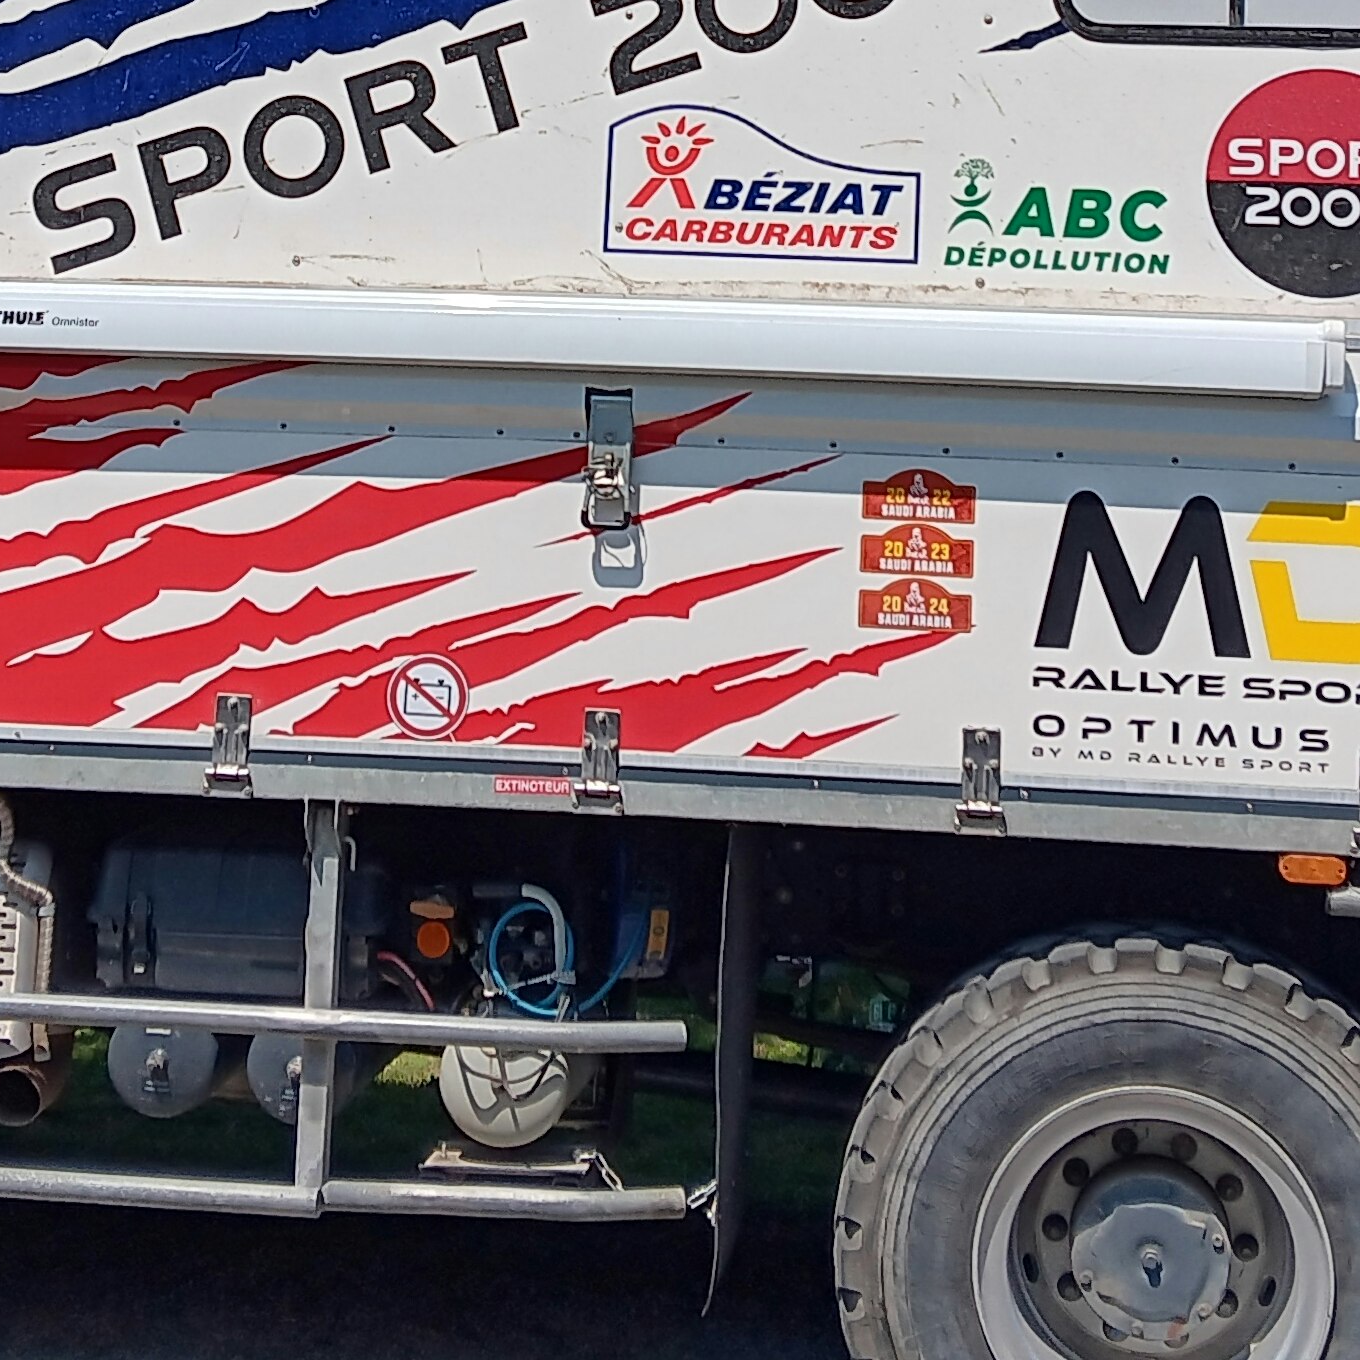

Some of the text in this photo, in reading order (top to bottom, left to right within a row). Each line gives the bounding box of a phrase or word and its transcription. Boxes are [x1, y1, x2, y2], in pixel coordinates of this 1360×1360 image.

[33, 22, 530, 274] SPORT
[704, 171, 904, 216] BÉZIAT
[1002, 186, 1168, 242] ABC
[624, 217, 898, 250] CARBURANTS
[944, 241, 1171, 275] DÉPOLLUTION
[886, 487, 905, 503] 20
[932, 489, 952, 506] 22
[881, 505, 956, 519] SAUDI ARABIA
[884, 540, 903, 557] 20
[931, 542, 950, 560] 23
[879, 557, 954, 573] SAUDI ARABIA
[882, 595, 901, 612] 20
[929, 597, 949, 615] 24
[878, 612, 952, 628] SAUDI ARABIA
[1032, 666, 1226, 697] RALLYE
[1032, 714, 1330, 753] OPTIMUS
[1032, 746, 1330, 774] BY MD RALLYE SPORT
